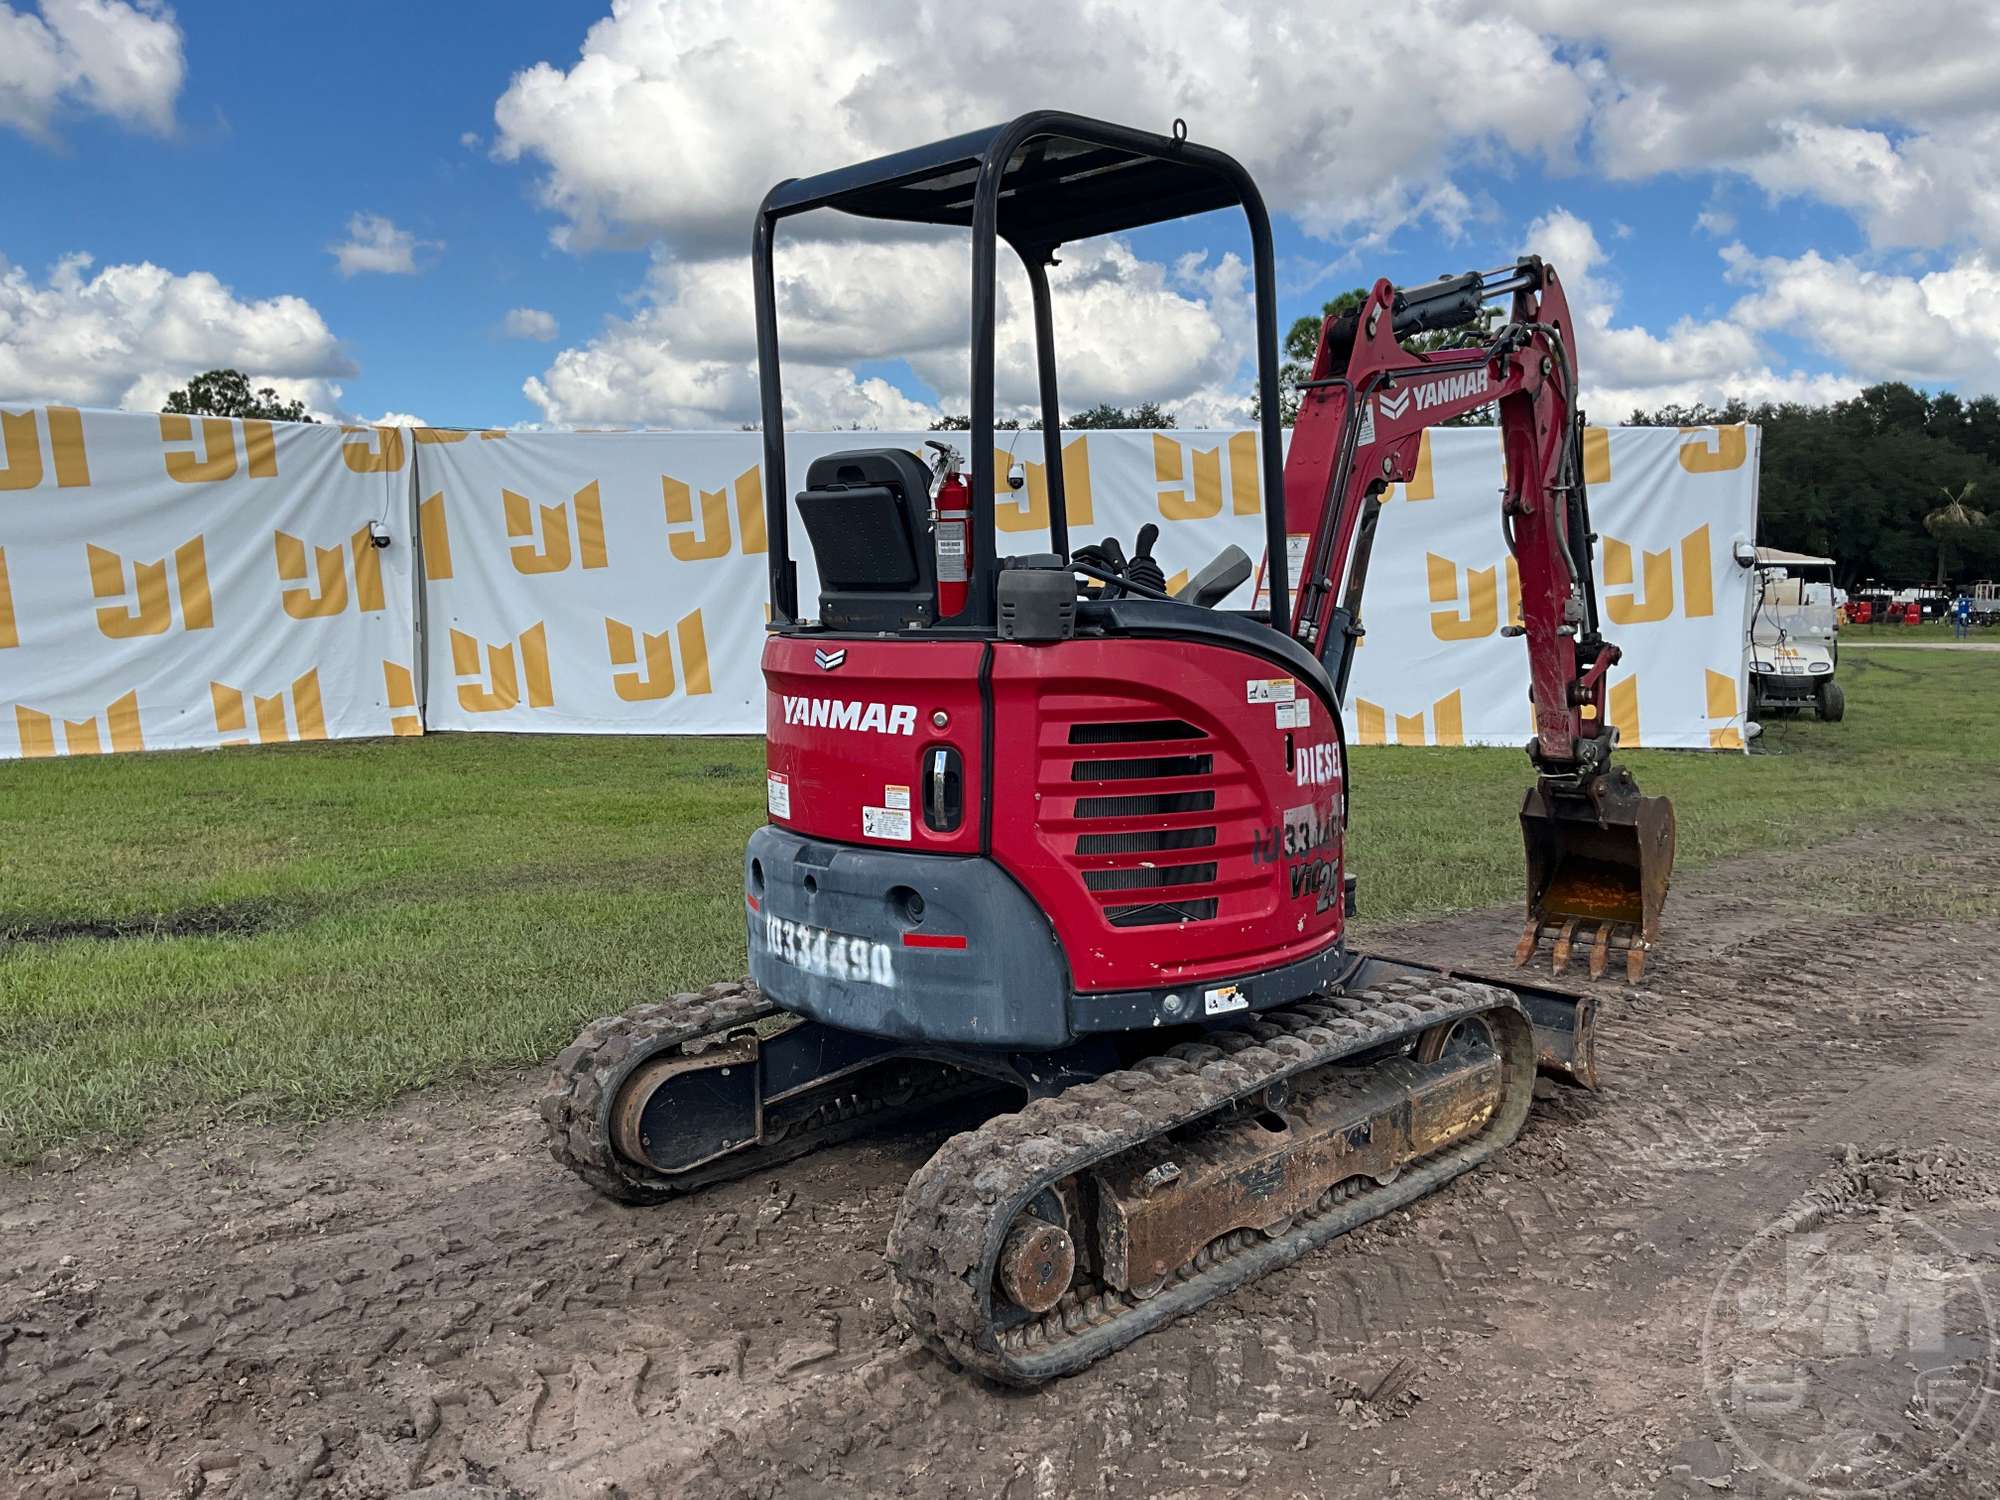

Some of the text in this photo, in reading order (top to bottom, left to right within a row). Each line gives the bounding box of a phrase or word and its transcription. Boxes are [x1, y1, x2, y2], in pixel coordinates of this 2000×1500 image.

[1412, 367, 1489, 411] YANMAR
[783, 695, 918, 736] YANMAR
[1296, 741, 1342, 786] DIESEL
[766, 911, 896, 987] 10334490
